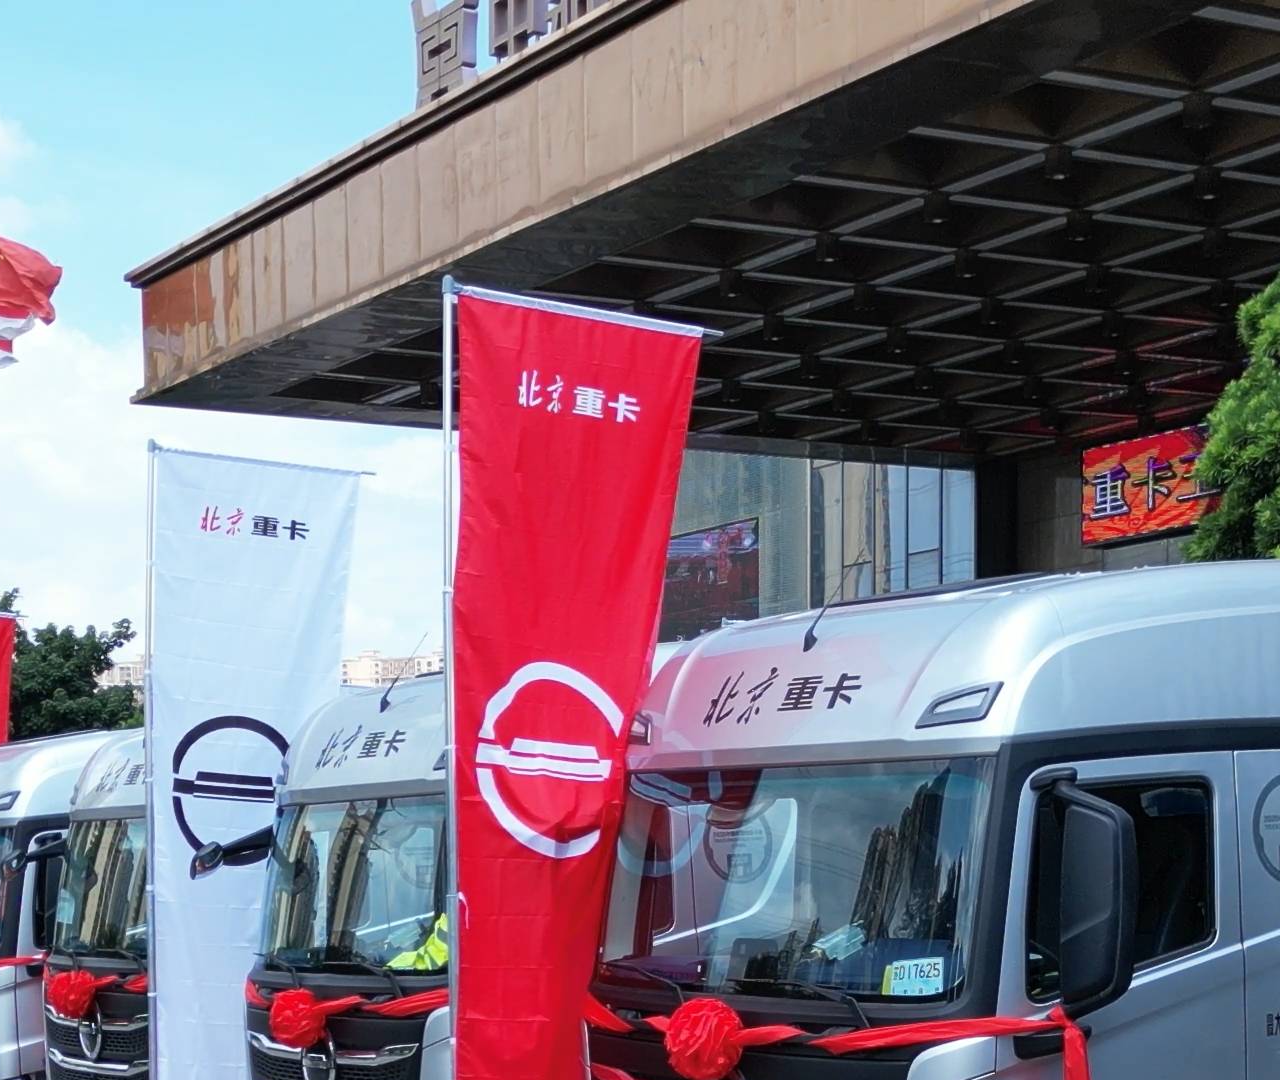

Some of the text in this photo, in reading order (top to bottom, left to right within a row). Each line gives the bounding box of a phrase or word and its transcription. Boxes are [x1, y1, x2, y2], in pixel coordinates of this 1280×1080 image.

[518, 369, 641, 423] 北京重卡
[200, 506, 310, 541] 北京重卡
[703, 667, 862, 727] 北京重卡
[315, 724, 407, 769] 北京重卡
[95, 757, 146, 792] 北京重
